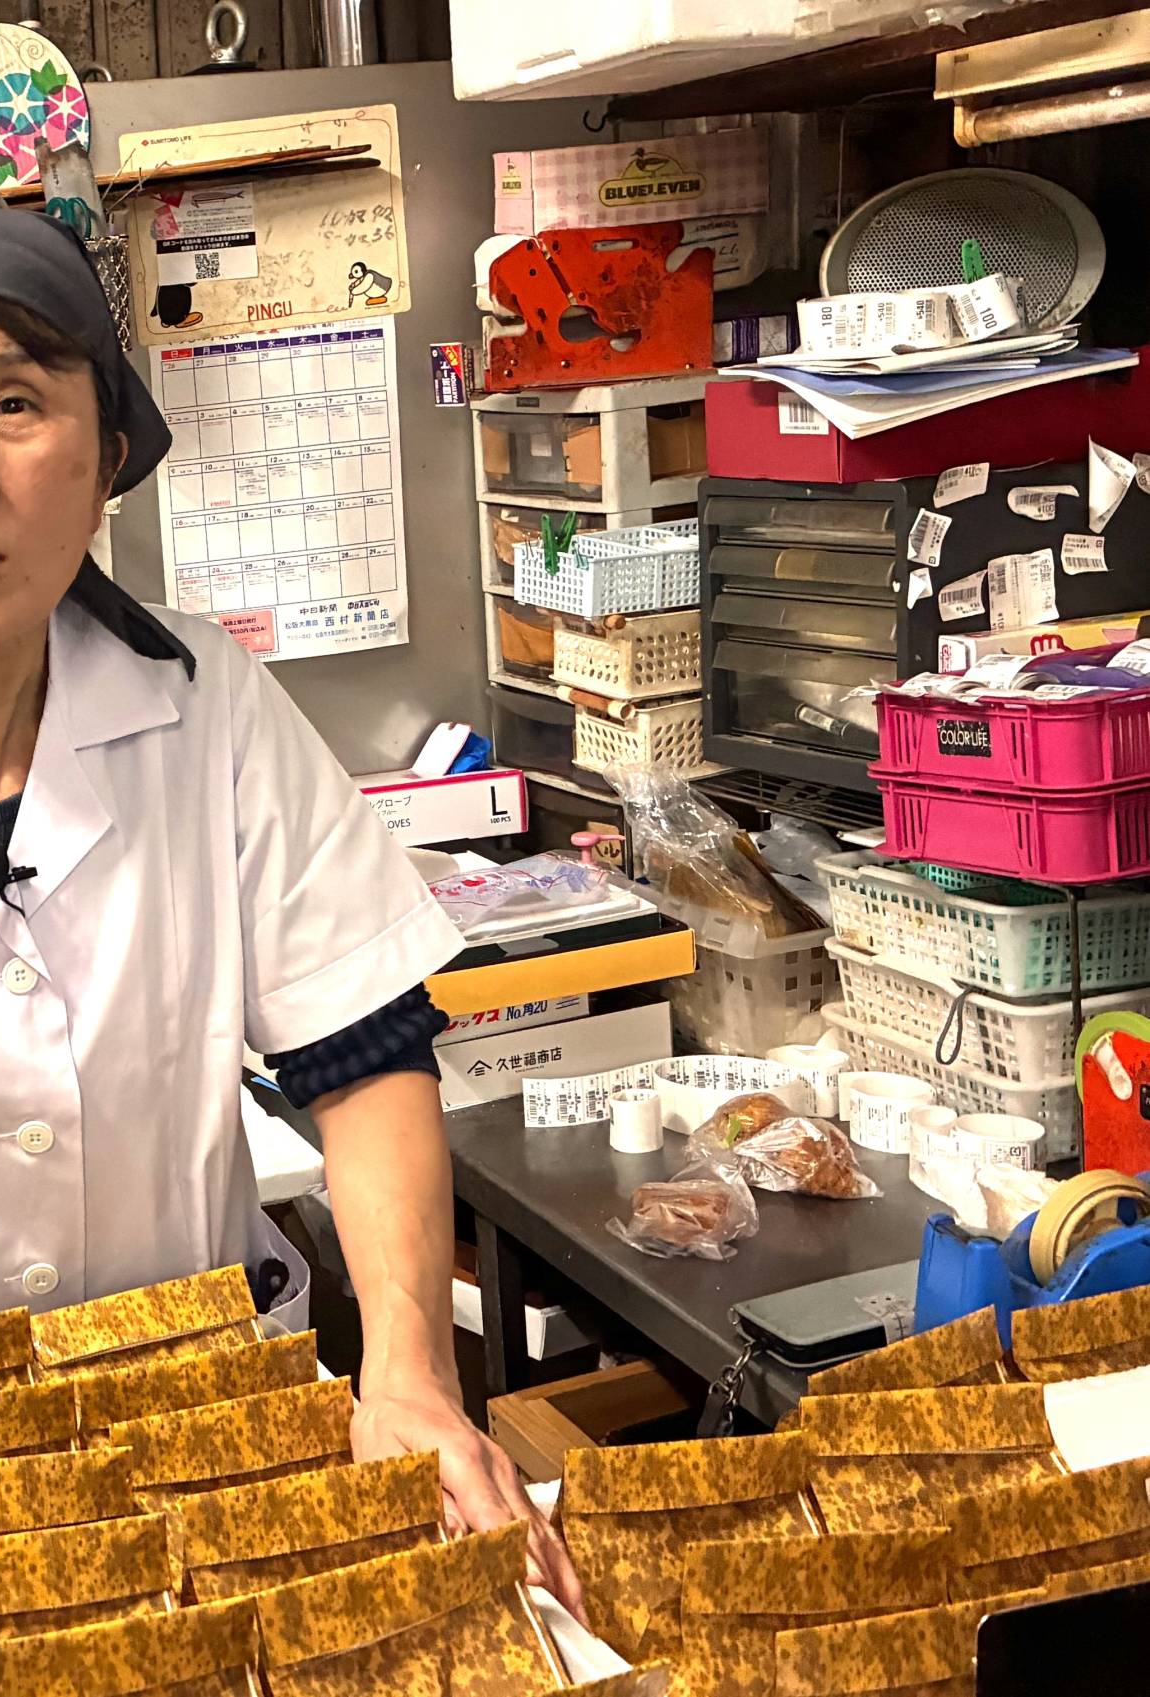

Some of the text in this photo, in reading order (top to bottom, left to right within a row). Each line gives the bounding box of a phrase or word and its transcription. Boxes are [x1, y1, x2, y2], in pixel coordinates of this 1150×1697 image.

[247, 301, 293, 322] PINGU
[821, 306, 833, 327] 180
[980, 306, 998, 330] 100
[300, 603, 338, 616] 中日新聞
[325, 609, 390, 627] 西村新聞店
[940, 730, 970, 745] COLOR
[490, 785, 508, 817] L
[387, 818, 411, 829] OVES
[496, 1047, 562, 1072] 久世福商店
